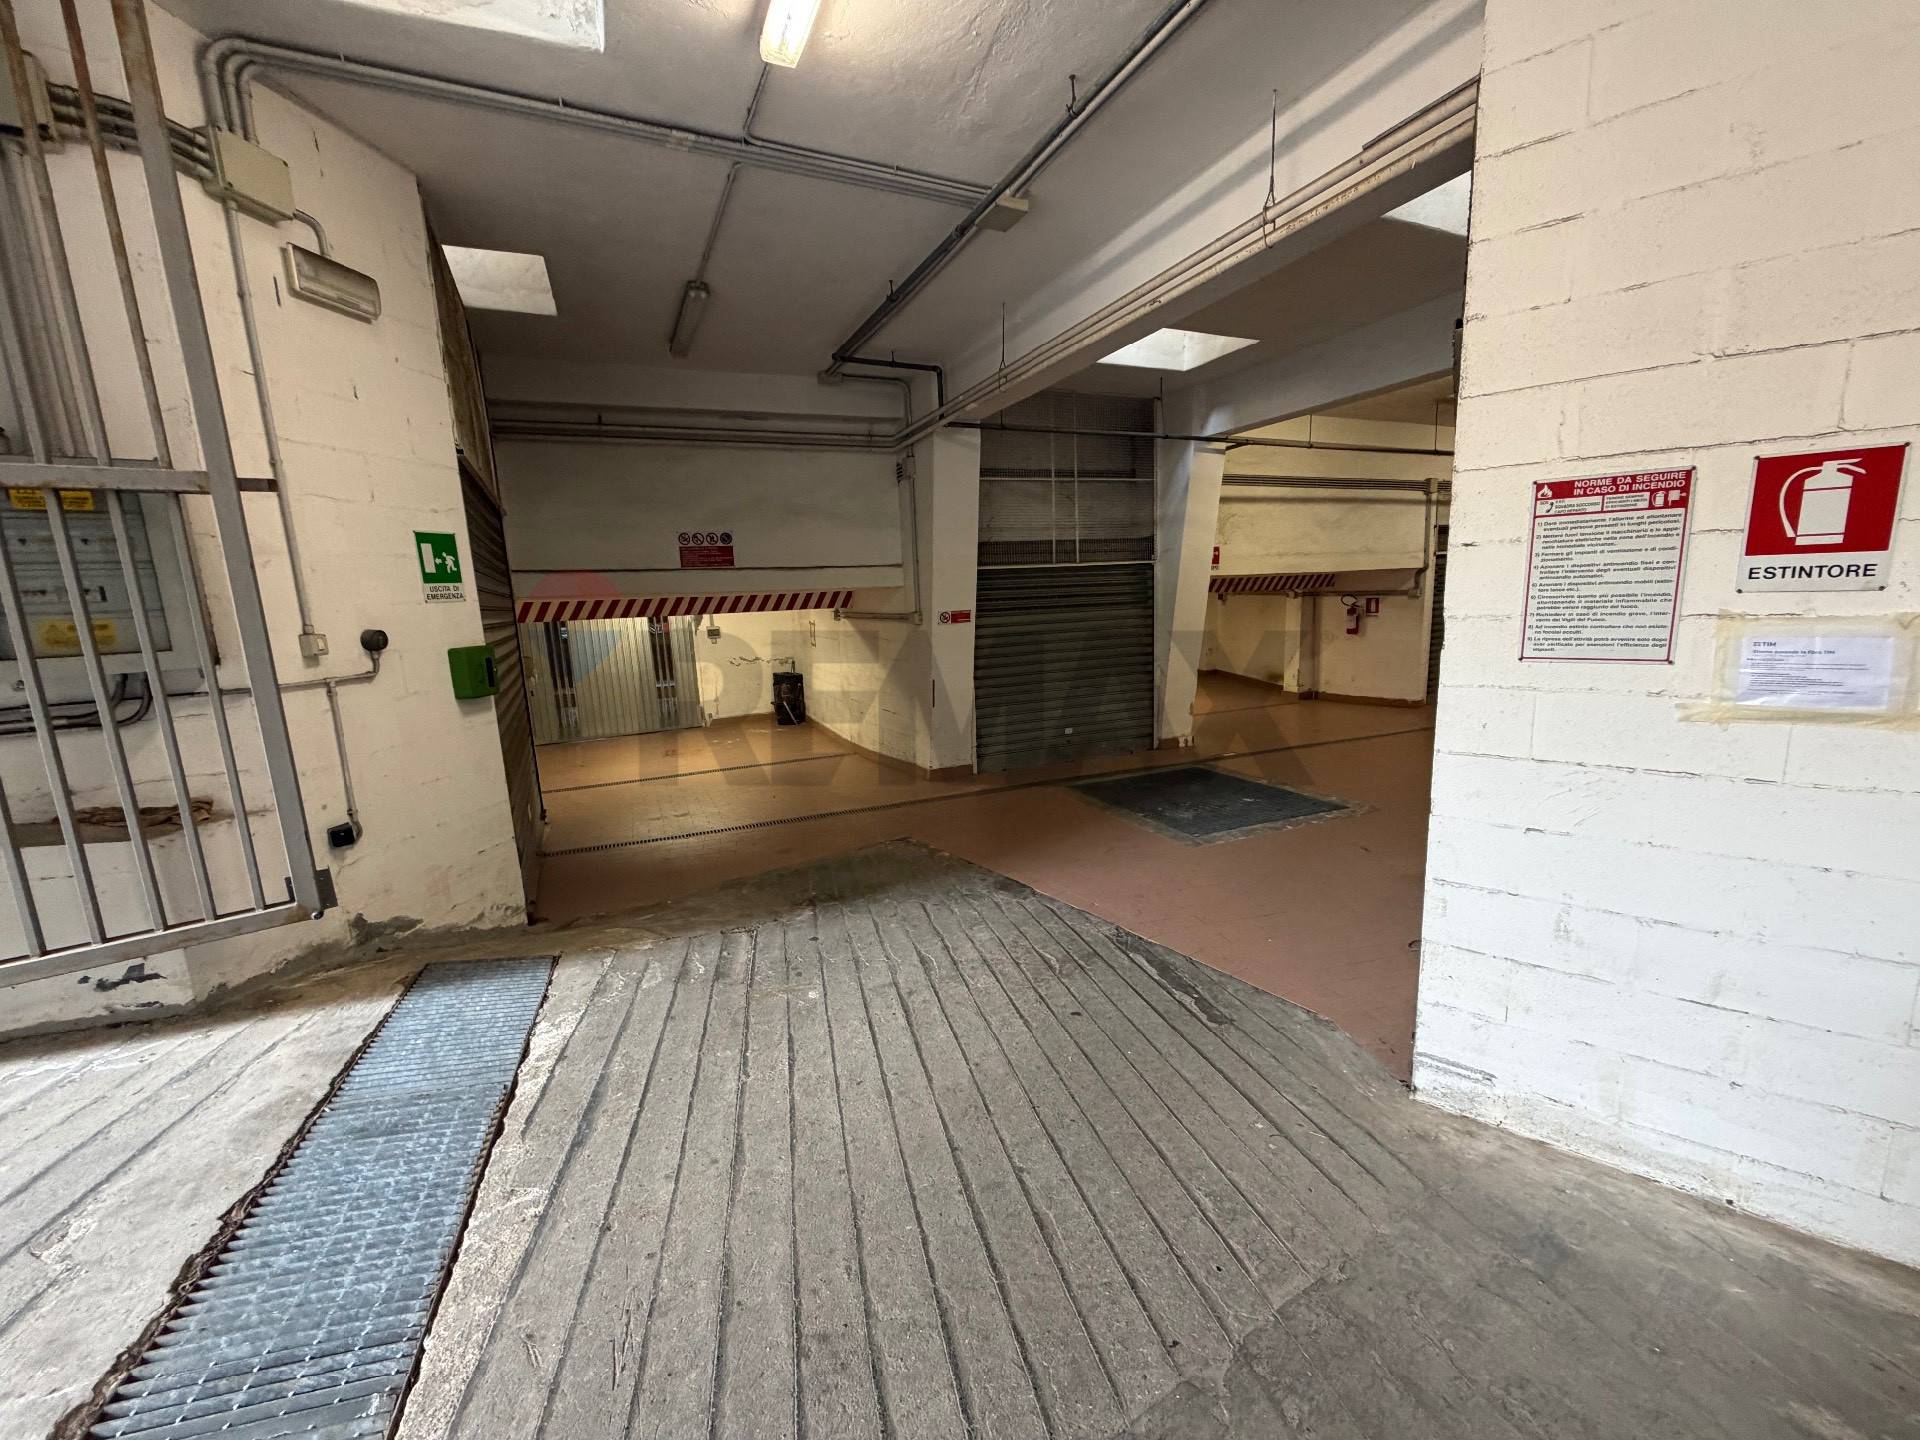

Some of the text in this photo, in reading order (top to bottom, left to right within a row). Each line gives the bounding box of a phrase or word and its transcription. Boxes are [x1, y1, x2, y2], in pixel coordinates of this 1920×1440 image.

[1574, 470, 1686, 487] NORME DA SEGUIRE
[1586, 485, 1615, 494] CASO
[1632, 479, 1685, 490] INCENDIO
[1748, 563, 1878, 580] ESTINTORE
[426, 592, 464, 600] EMERGENZA
